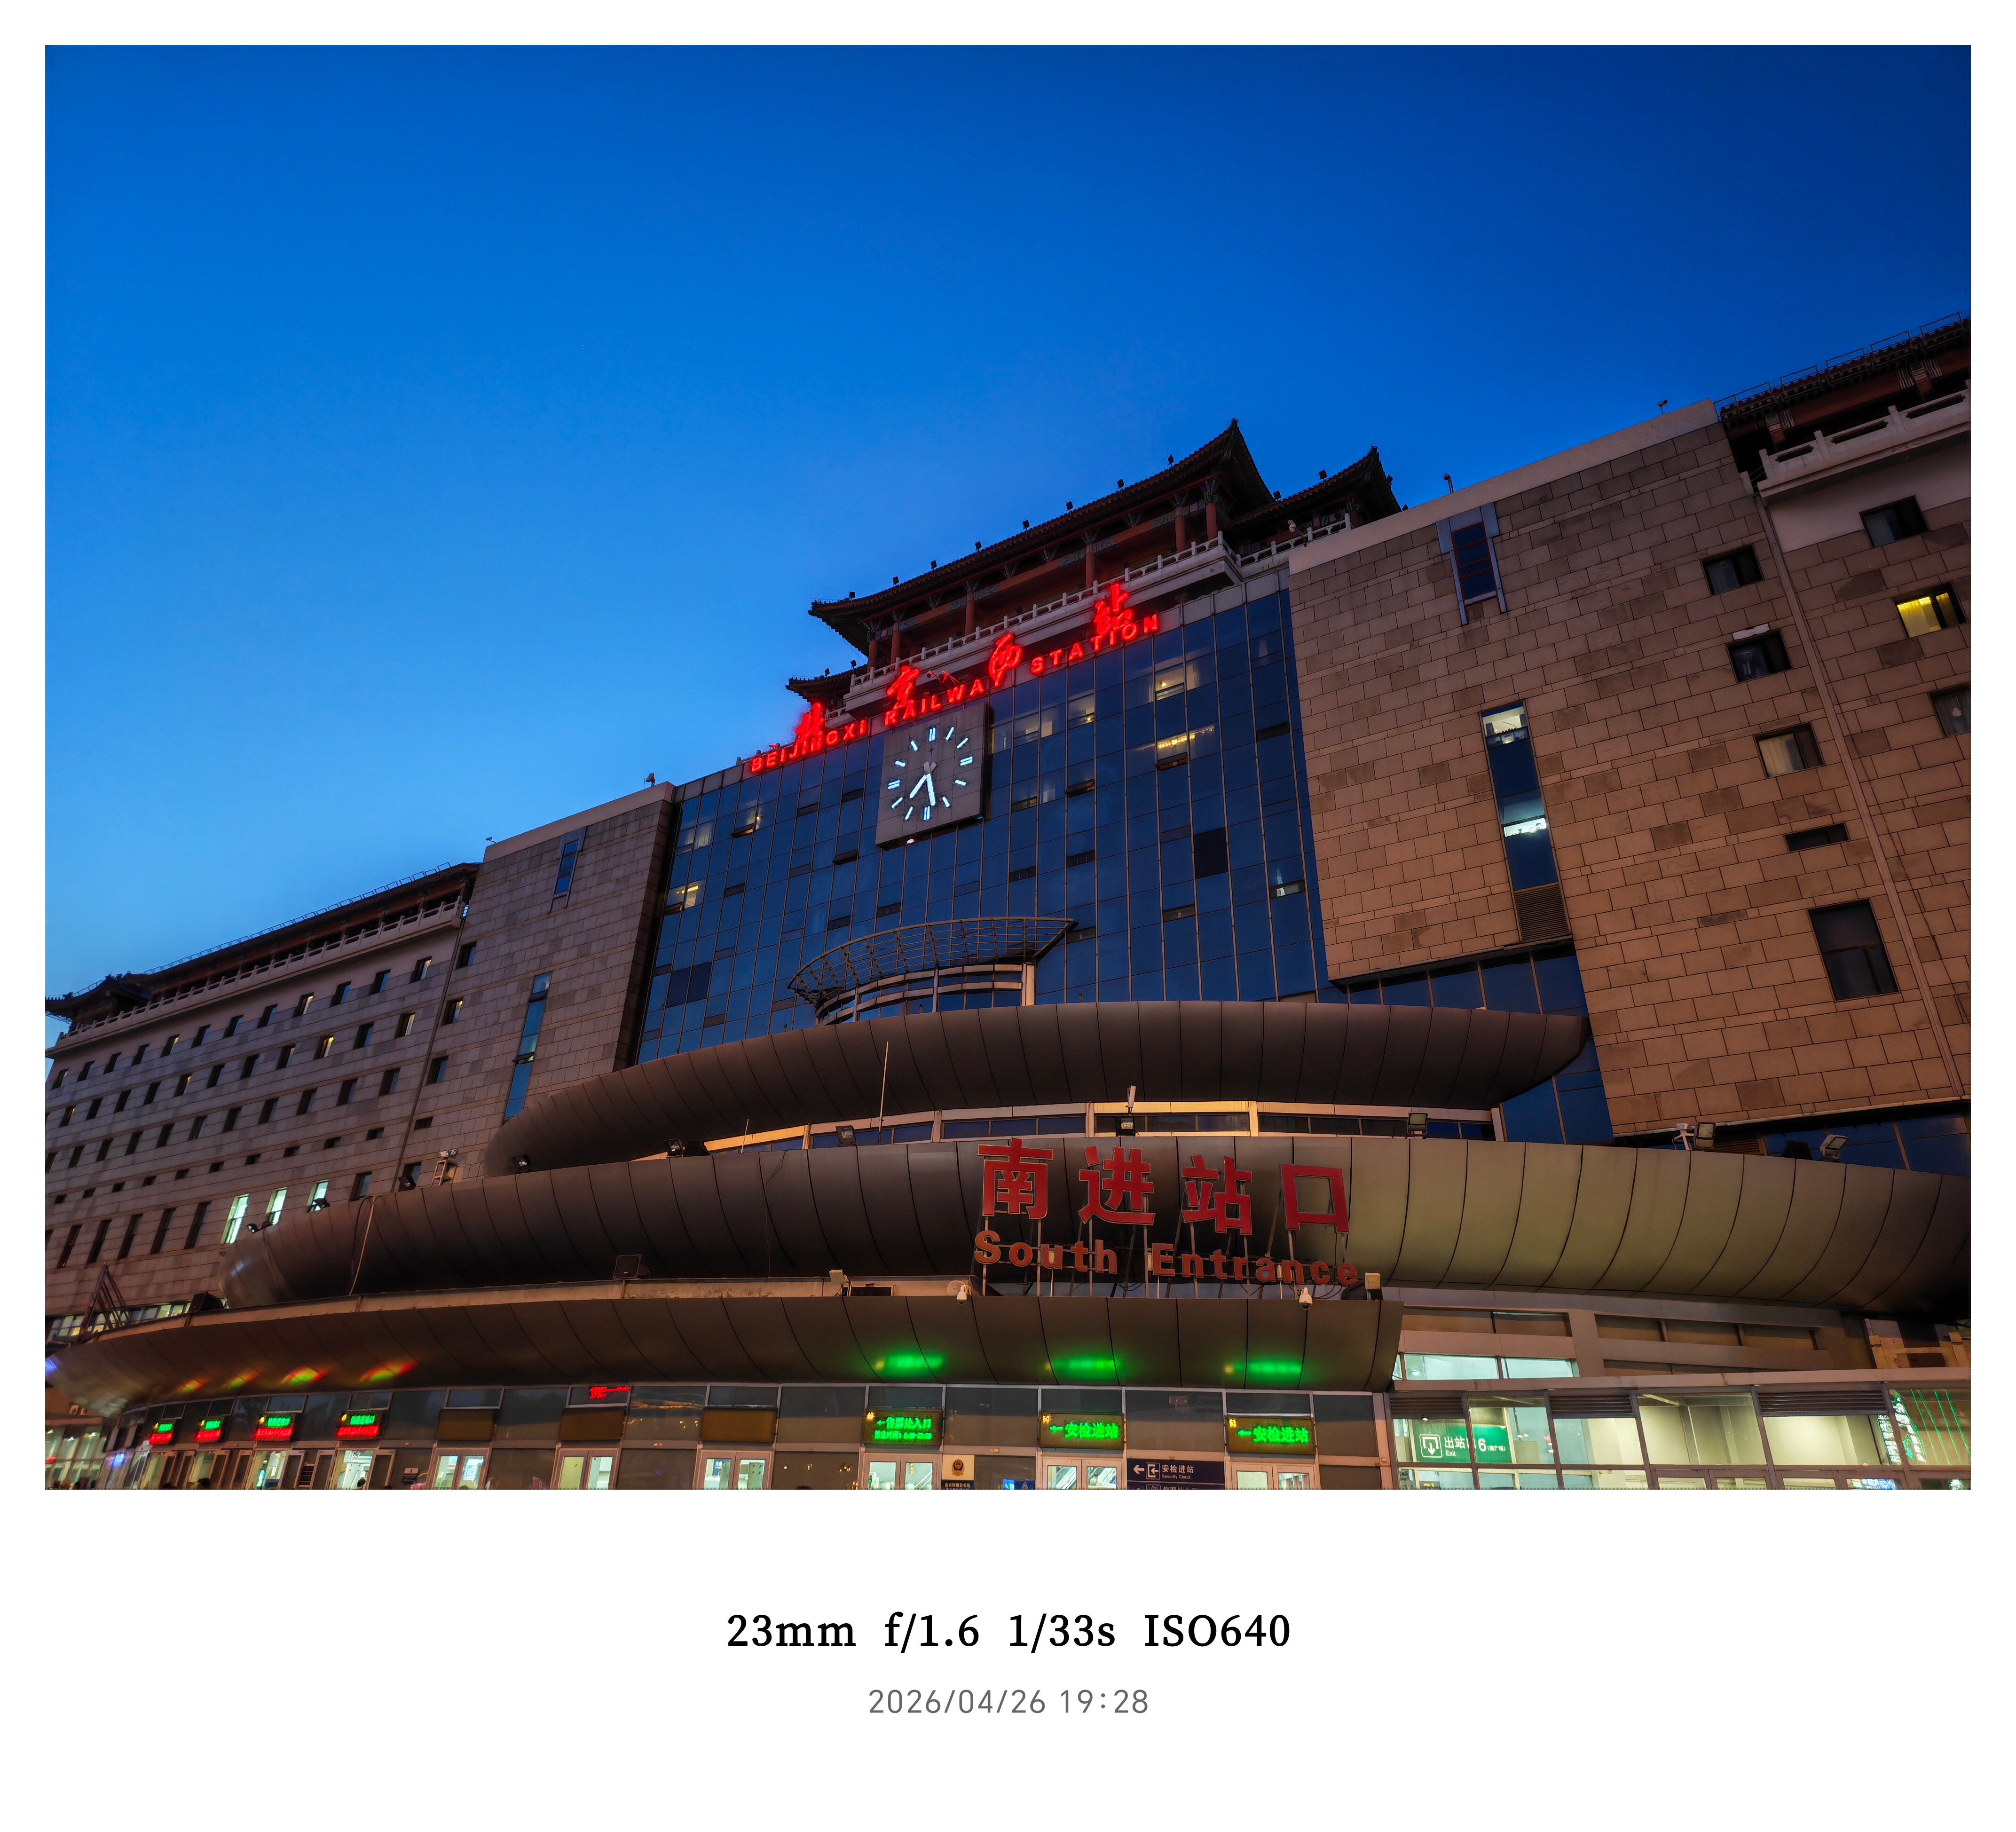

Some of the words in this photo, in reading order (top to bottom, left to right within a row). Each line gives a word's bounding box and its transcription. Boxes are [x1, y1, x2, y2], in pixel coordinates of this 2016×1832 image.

[1030, 613, 1158, 673] STATION
[977, 1138, 1350, 1236] 南进站口
[974, 1230, 1118, 1275] South
[1151, 1243, 1359, 1287] Entrance
[1064, 1421, 1118, 1439] 安检进站
[1253, 1426, 1308, 1444] 安检进站
[1162, 1464, 1194, 1474] 安检进站
